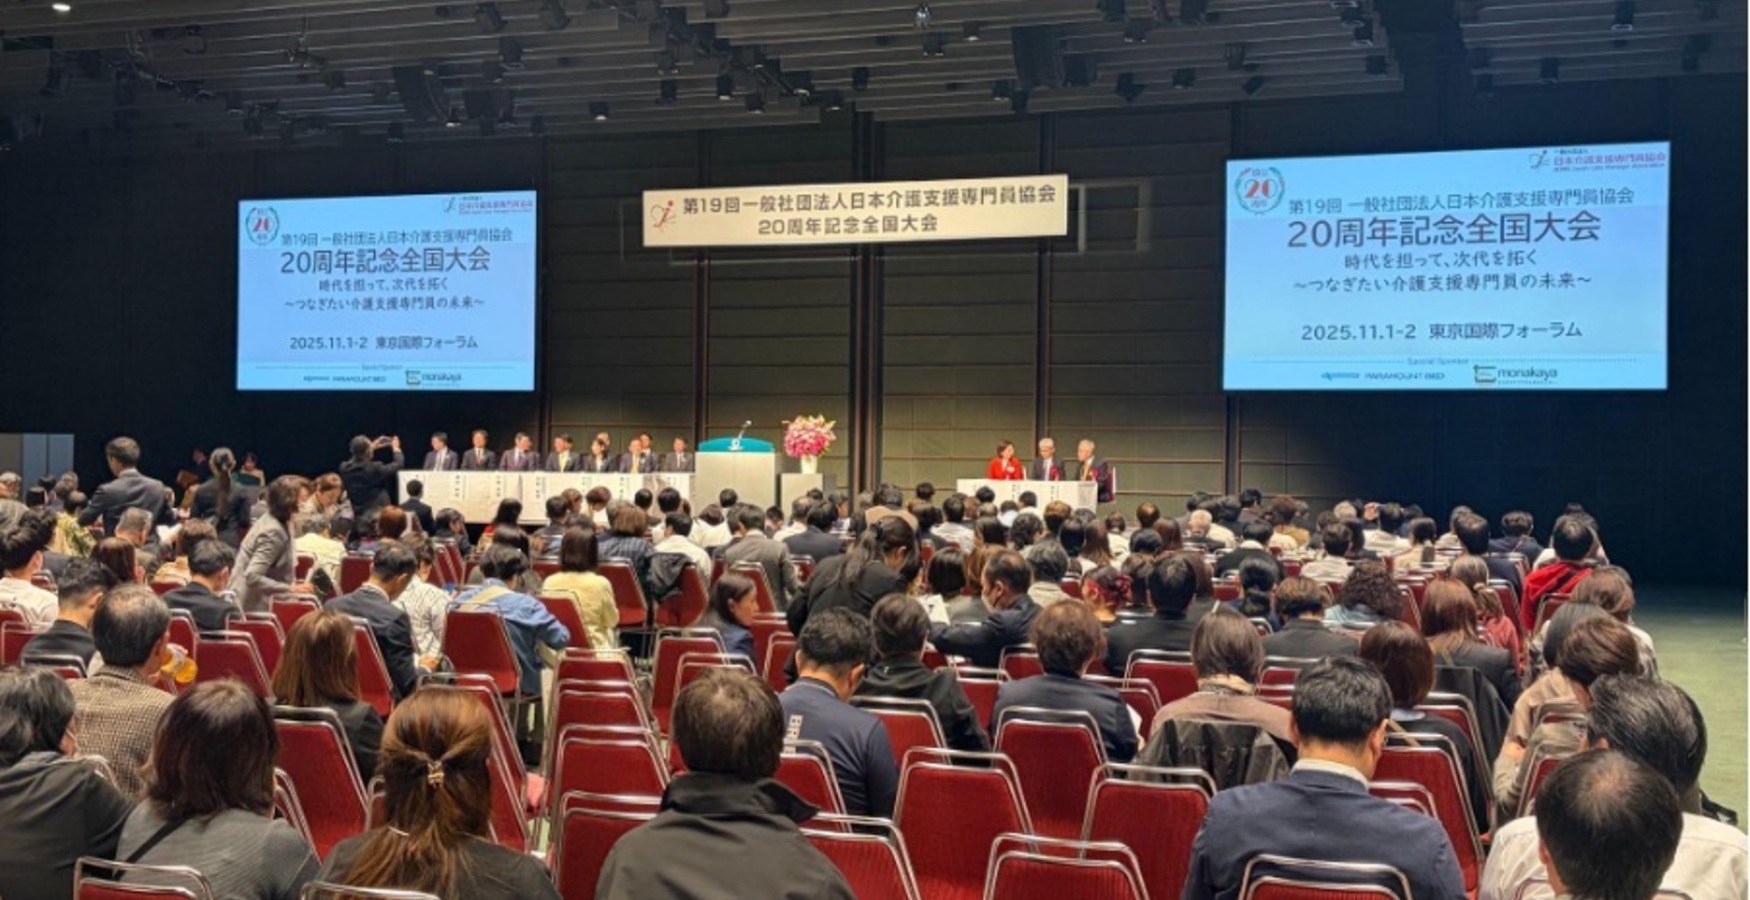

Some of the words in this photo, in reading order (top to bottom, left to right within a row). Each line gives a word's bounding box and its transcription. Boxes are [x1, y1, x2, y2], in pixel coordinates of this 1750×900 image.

[1244, 179, 1278, 199] 20
[1288, 198, 1342, 215] 第19回
[1348, 187, 1635, 213] 一般社団法人日本介護支援専門員協会
[758, 213, 939, 236] 20周年記念全国大会
[1287, 210, 1602, 249] 20周年記念全国大会
[281, 233, 318, 247] 第19回
[280, 245, 491, 275] 20周年記念全国大会
[1344, 249, 1538, 270] 時代を担って、次代を拓く
[319, 277, 448, 292] 時代を担って、次代を拓く
[1301, 323, 1417, 341] 2025.11.1-2
[1429, 320, 1583, 340] 東京国際フォーラム
[290, 337, 369, 350] 2025.11.1-2
[375, 335, 478, 350] 東京国際フォーラム
